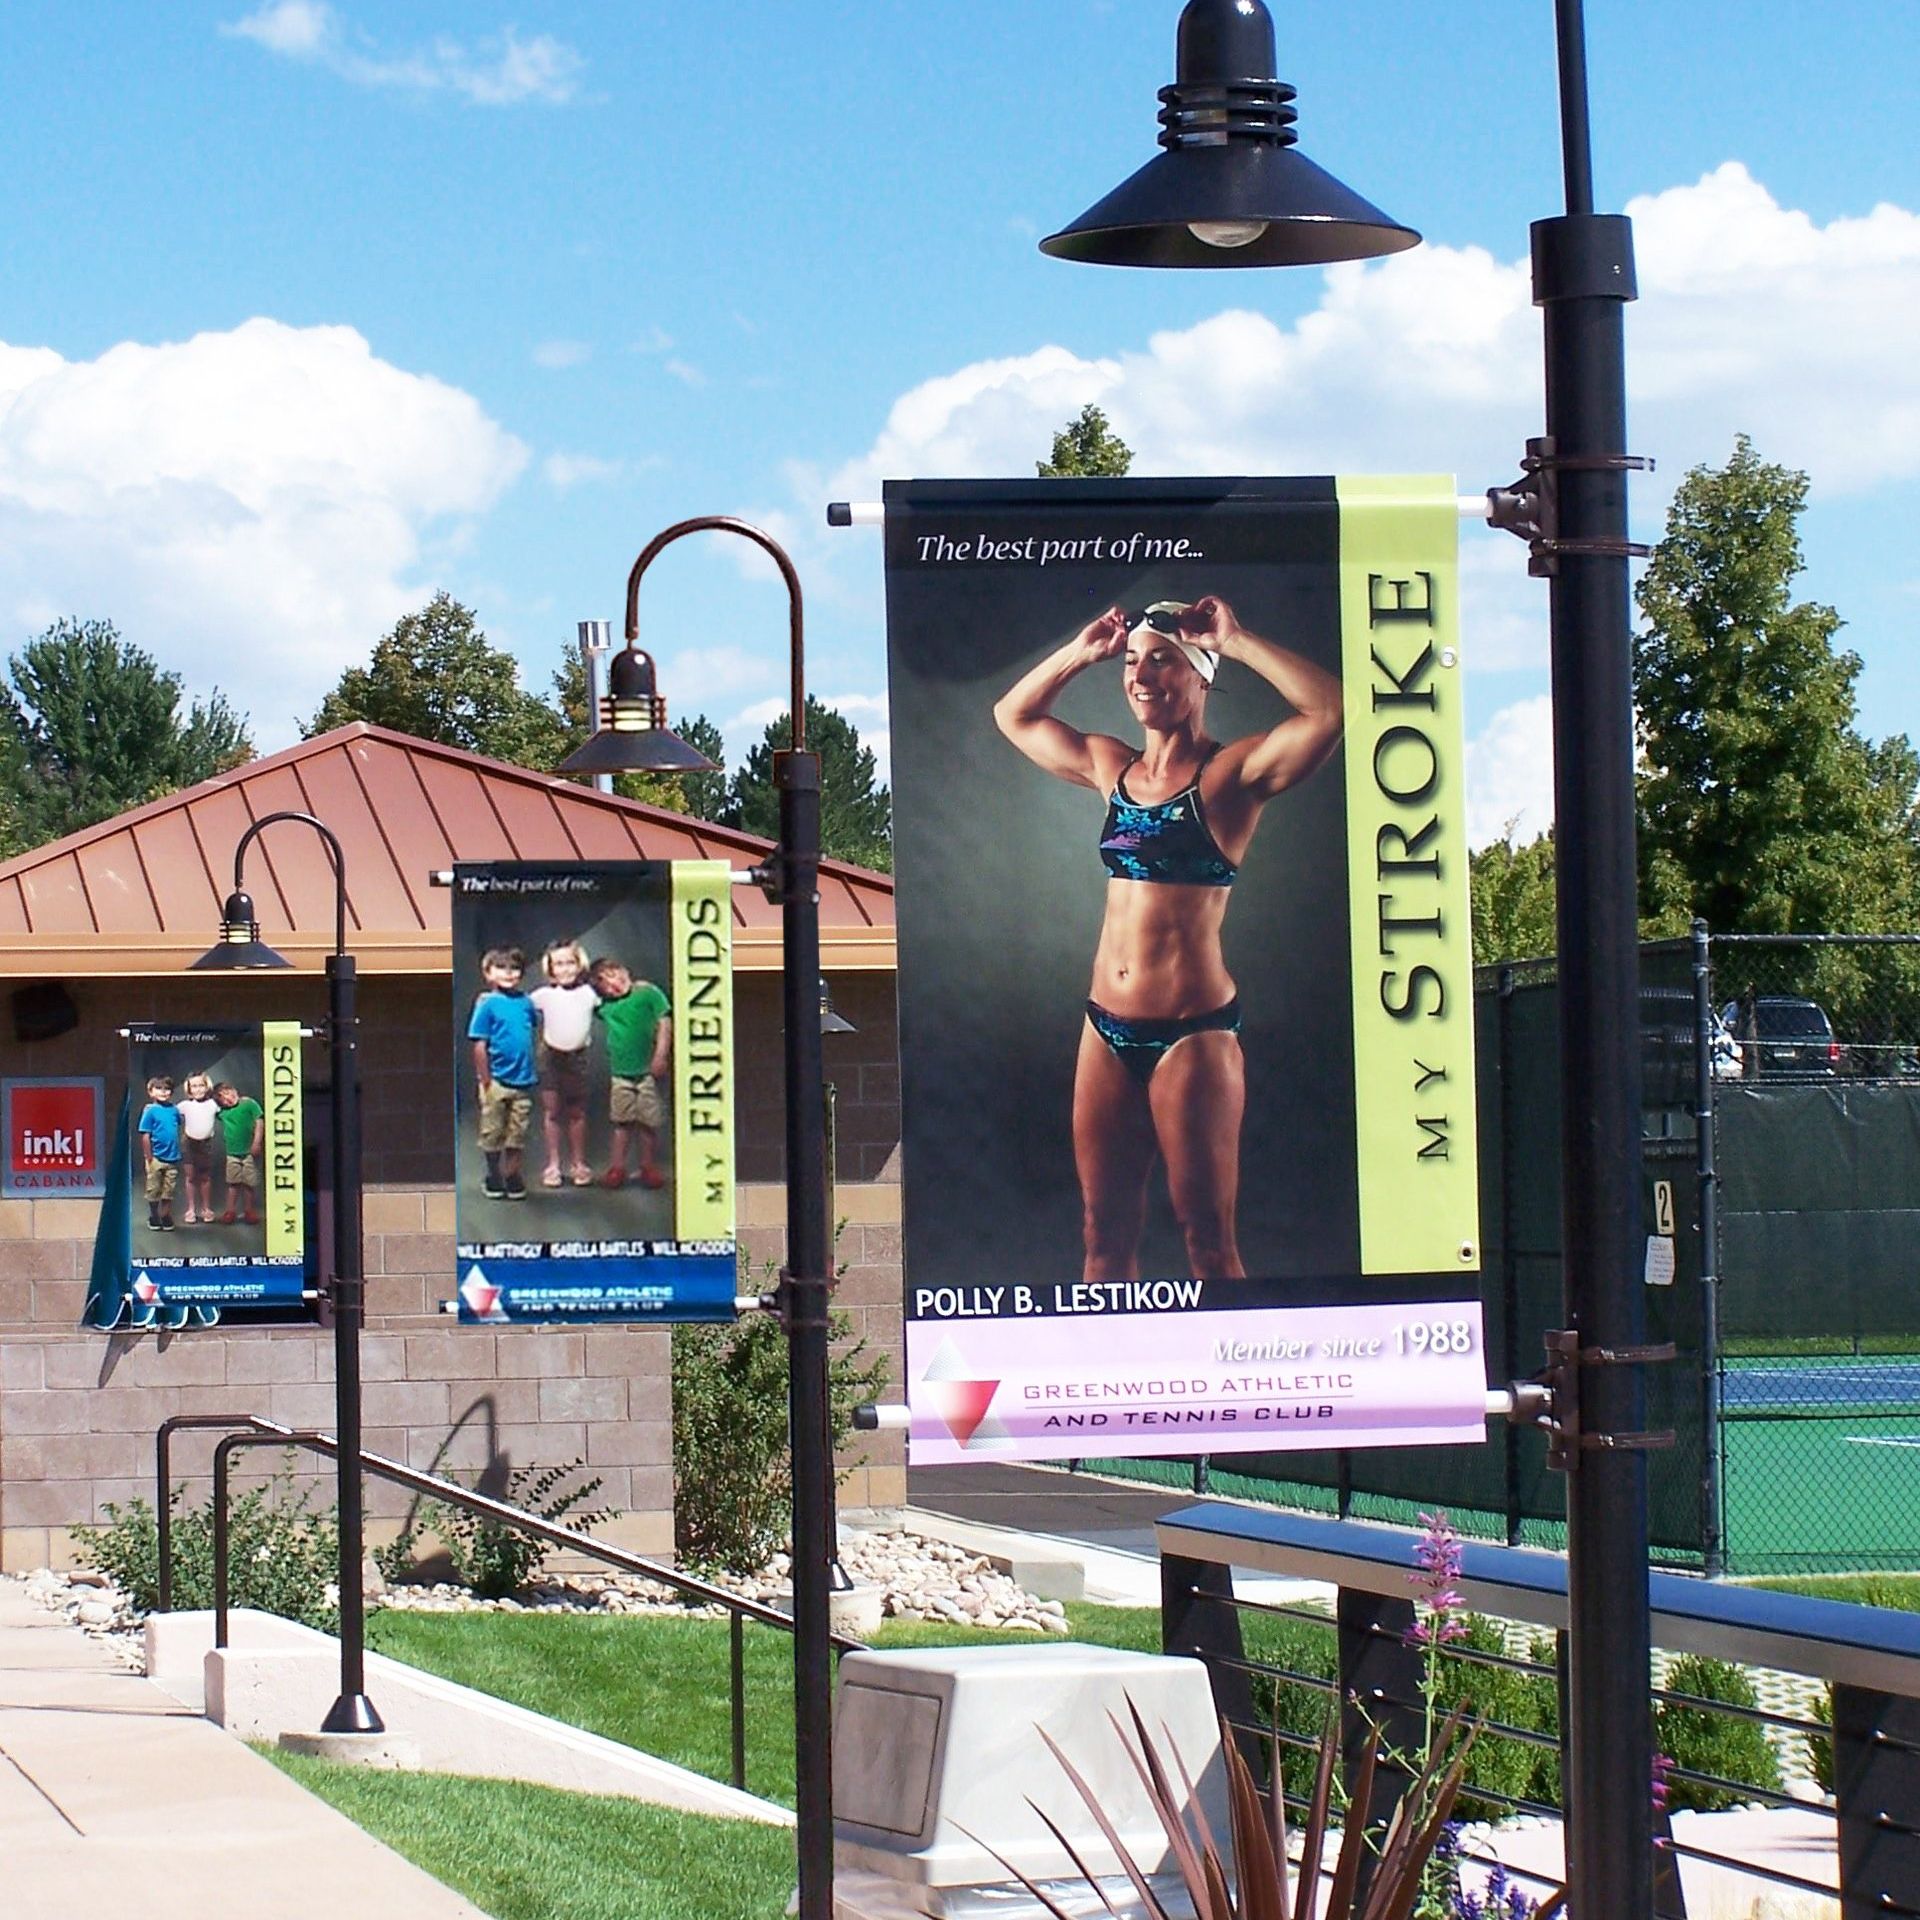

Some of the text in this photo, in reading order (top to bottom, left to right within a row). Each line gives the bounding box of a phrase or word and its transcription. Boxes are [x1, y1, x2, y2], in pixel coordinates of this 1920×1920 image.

[917, 532, 1204, 566] The best part of me...
[462, 877, 488, 892] The
[1368, 570, 1450, 1162] MY STROKE
[686, 898, 724, 1203] MY FRIENDS
[23, 1129, 84, 1166] ink!
[273, 1045, 296, 1234] MY FRIENDS
[14, 1175, 96, 1187] CABANA
[1659, 1184, 1669, 1227] 2
[458, 1244, 483, 1259] WILL
[652, 1241, 677, 1256] WILL
[915, 1280, 1203, 1317] POLLY B. LESTIKOW
[1213, 1320, 1471, 1362] Member since 1988
[1024, 1374, 1354, 1401] GREENWOOD ATHLETIC
[1044, 1405, 1334, 1428] AND TENNIS CLUB
